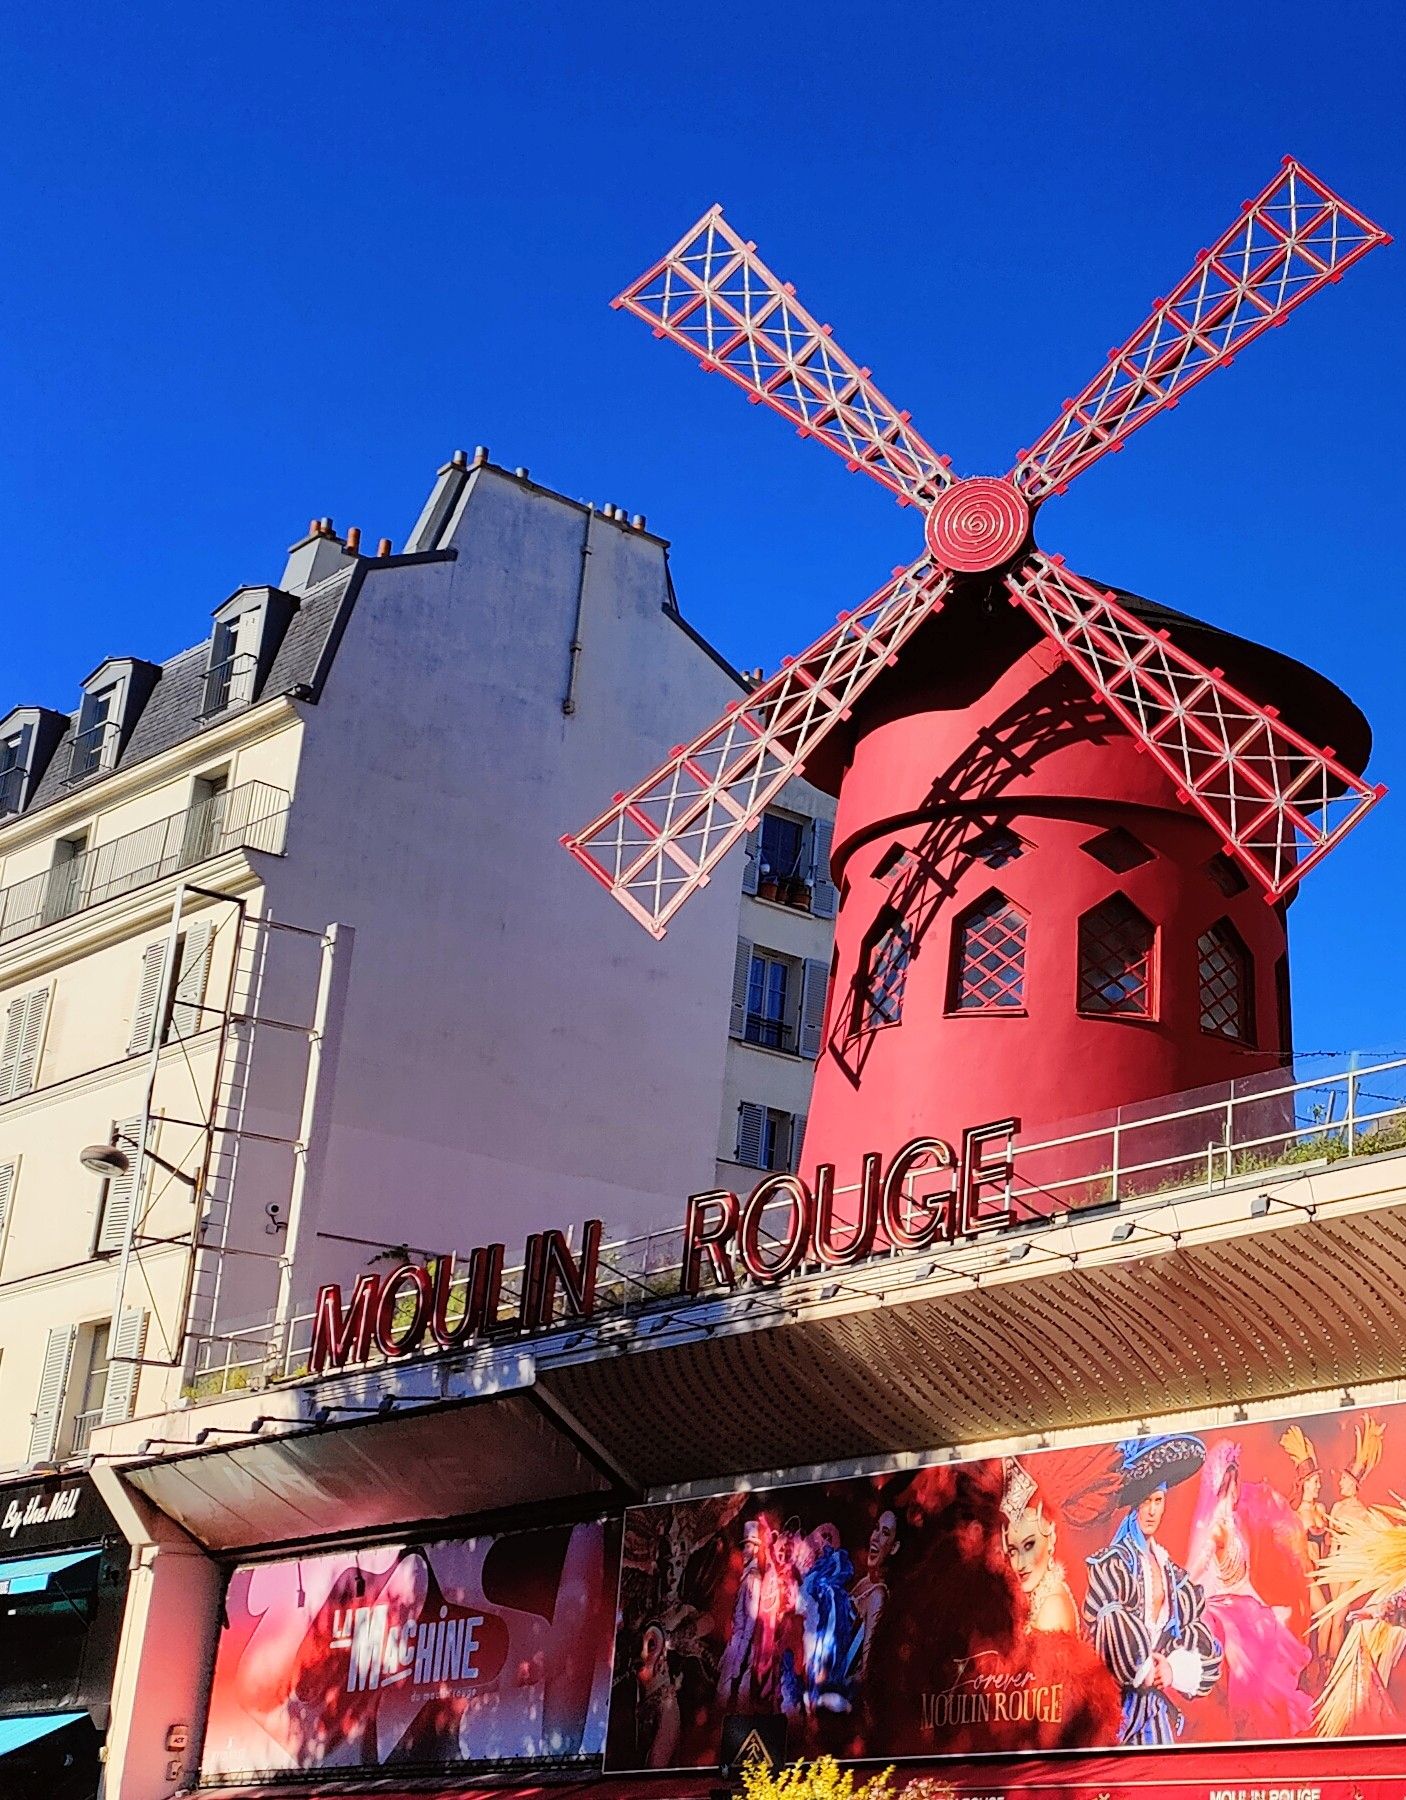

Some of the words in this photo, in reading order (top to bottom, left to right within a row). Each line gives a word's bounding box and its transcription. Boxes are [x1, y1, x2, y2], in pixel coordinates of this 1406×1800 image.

[308, 1219, 602, 1373] MOULIN
[680, 1116, 1022, 1296] ROUGE
[1, 1500, 23, 1538] By
[22, 1494, 47, 1526] the
[44, 1487, 81, 1523] Mill
[941, 1650, 1037, 1694] Forever
[920, 1692, 990, 1730] MOULIN
[993, 1684, 1063, 1723] ROUGE
